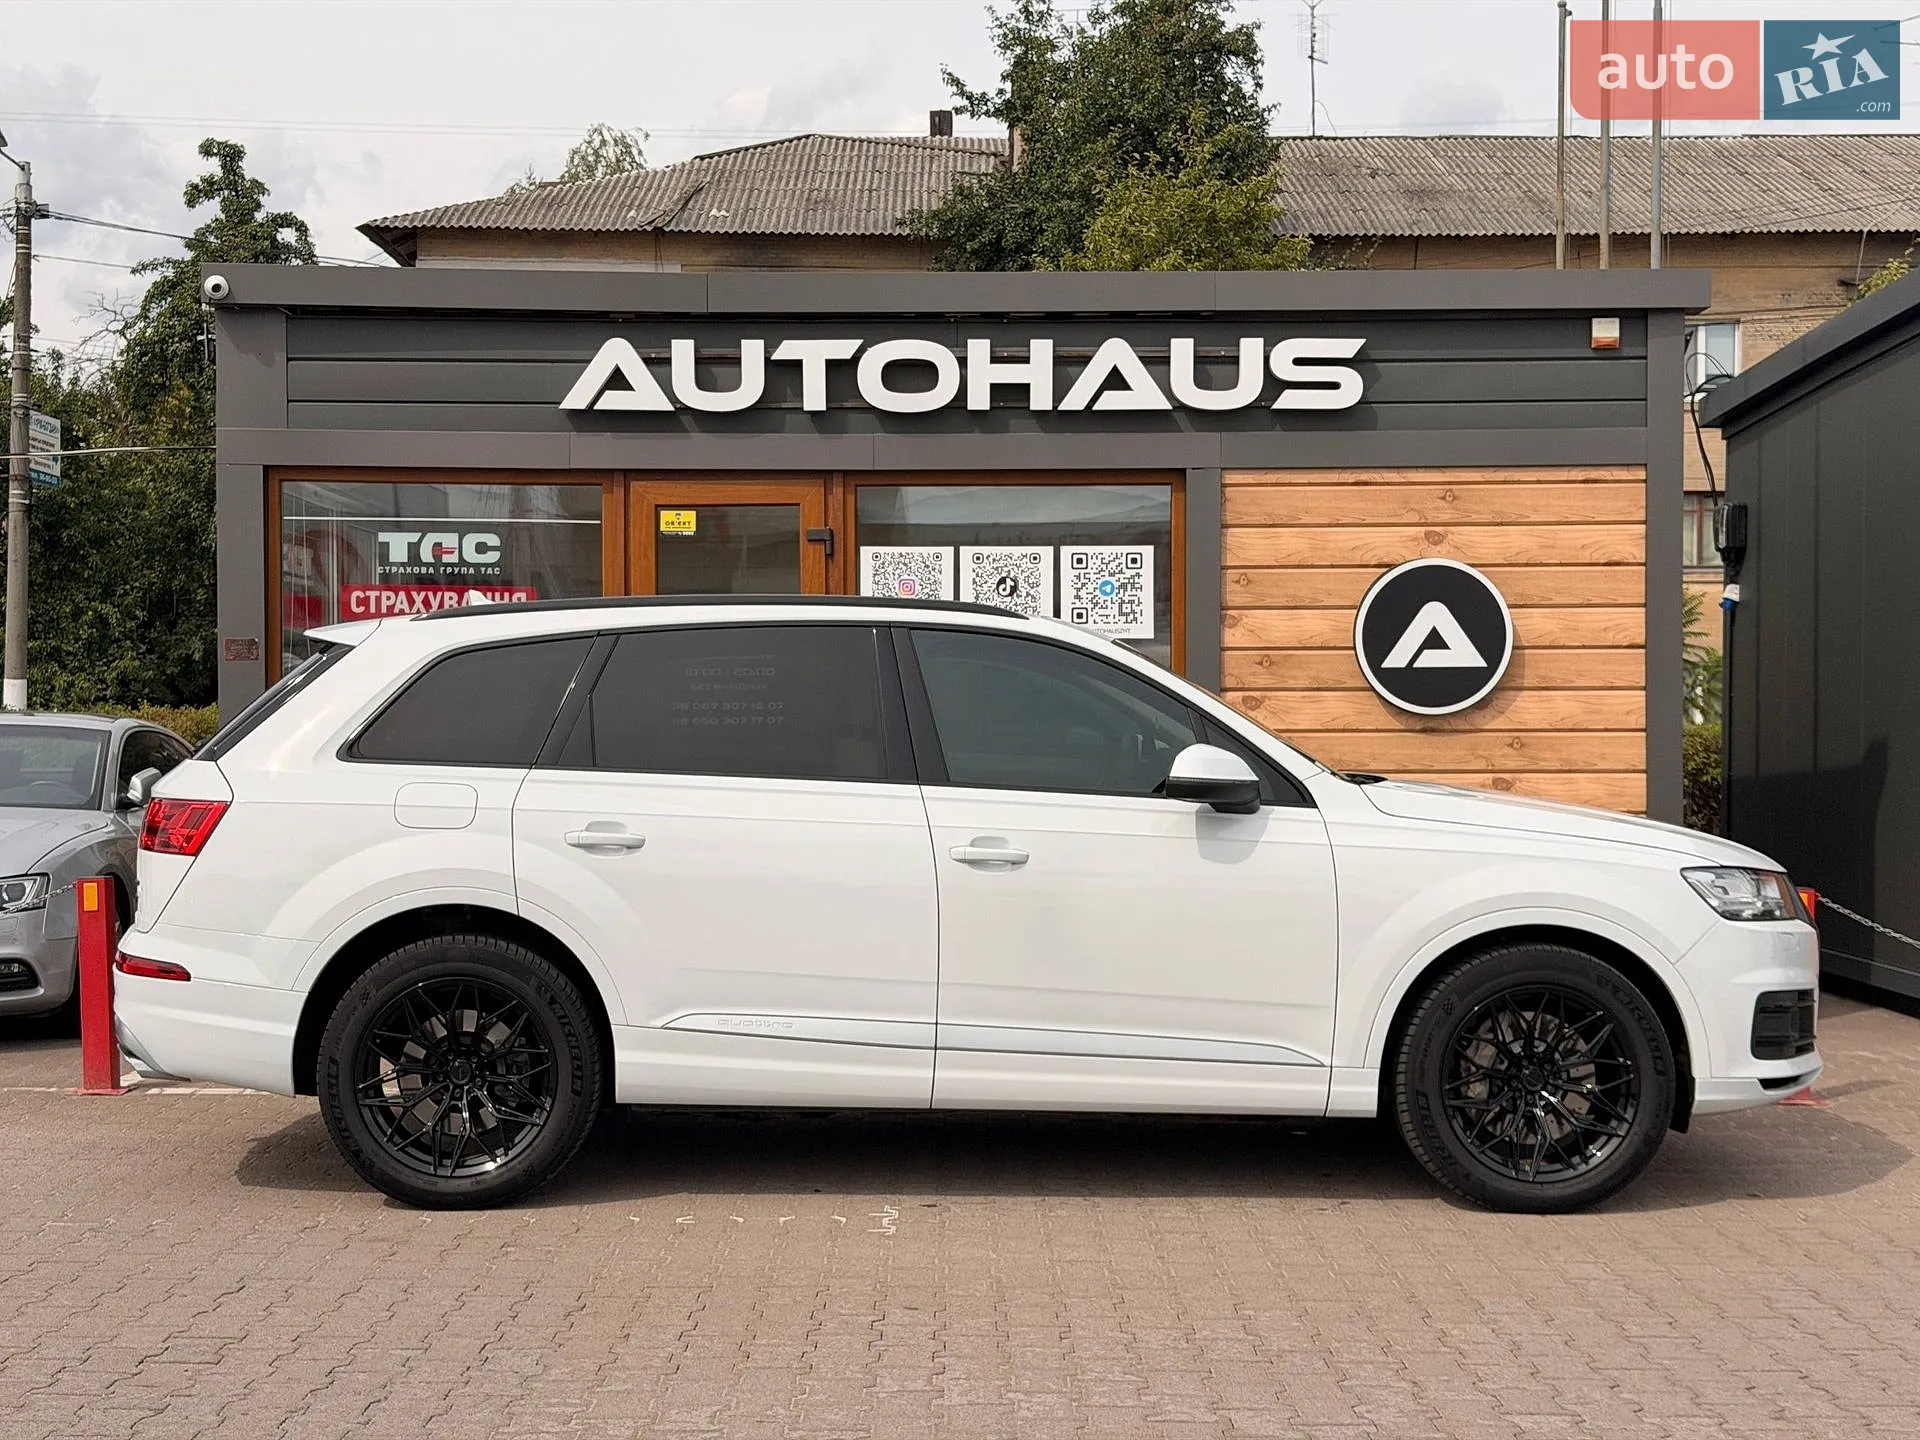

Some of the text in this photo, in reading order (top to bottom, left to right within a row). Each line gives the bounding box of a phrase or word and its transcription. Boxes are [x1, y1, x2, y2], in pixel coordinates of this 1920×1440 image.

[559, 337, 1367, 412] AUTOHAUS
[378, 566, 501, 575] СТРАХОВА ГРУПА ТАС
[1381, 601, 1488, 668] A
[549, 997, 584, 1096] MICHELIN
[716, 1018, 793, 1030] quattro
